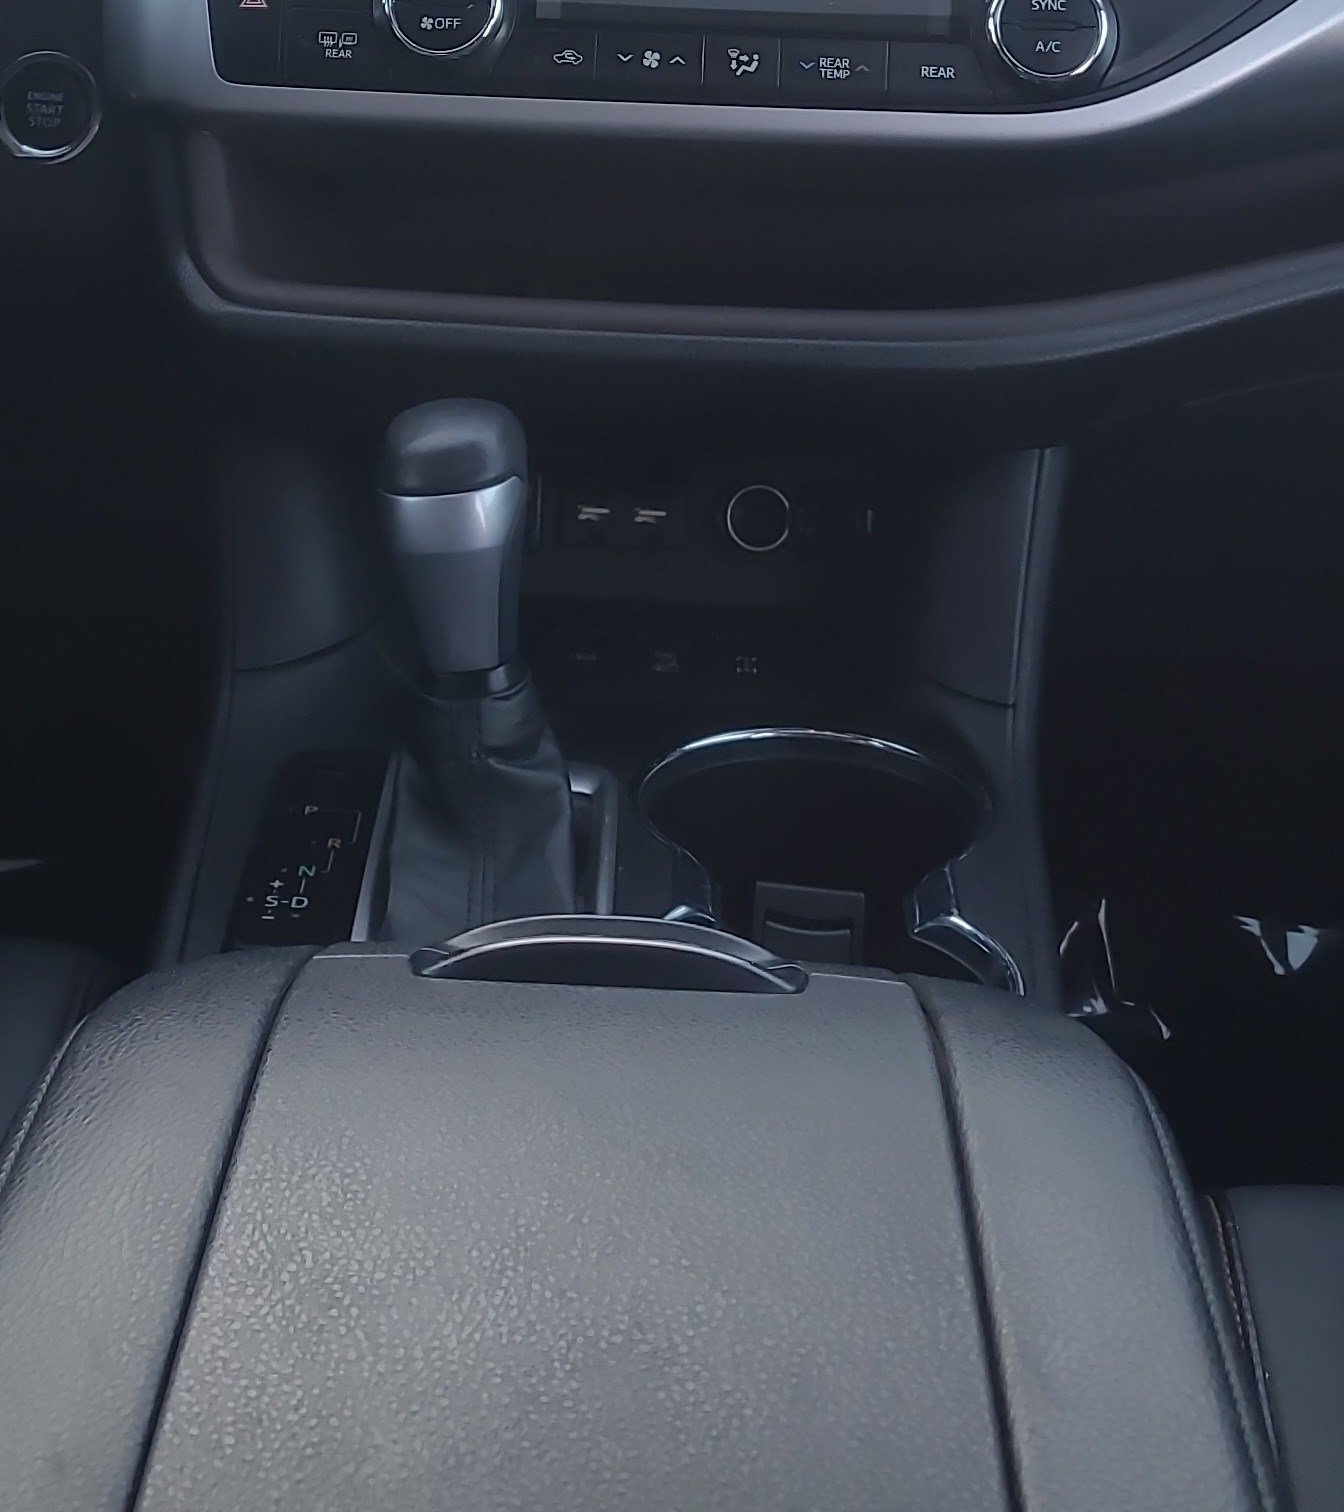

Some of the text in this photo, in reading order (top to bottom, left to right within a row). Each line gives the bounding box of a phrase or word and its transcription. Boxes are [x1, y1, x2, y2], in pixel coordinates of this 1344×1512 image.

[434, 18, 462, 30] OFF
[1034, 40, 1062, 54] A/C
[325, 48, 353, 59] REAR
[818, 57, 851, 69] REAR
[819, 68, 852, 80] TEMP
[920, 65, 956, 79] REAR
[26, 102, 65, 116] START
[28, 116, 62, 128] STOP
[304, 805, 319, 815] P
[327, 838, 342, 849] R
[298, 865, 316, 877] N
